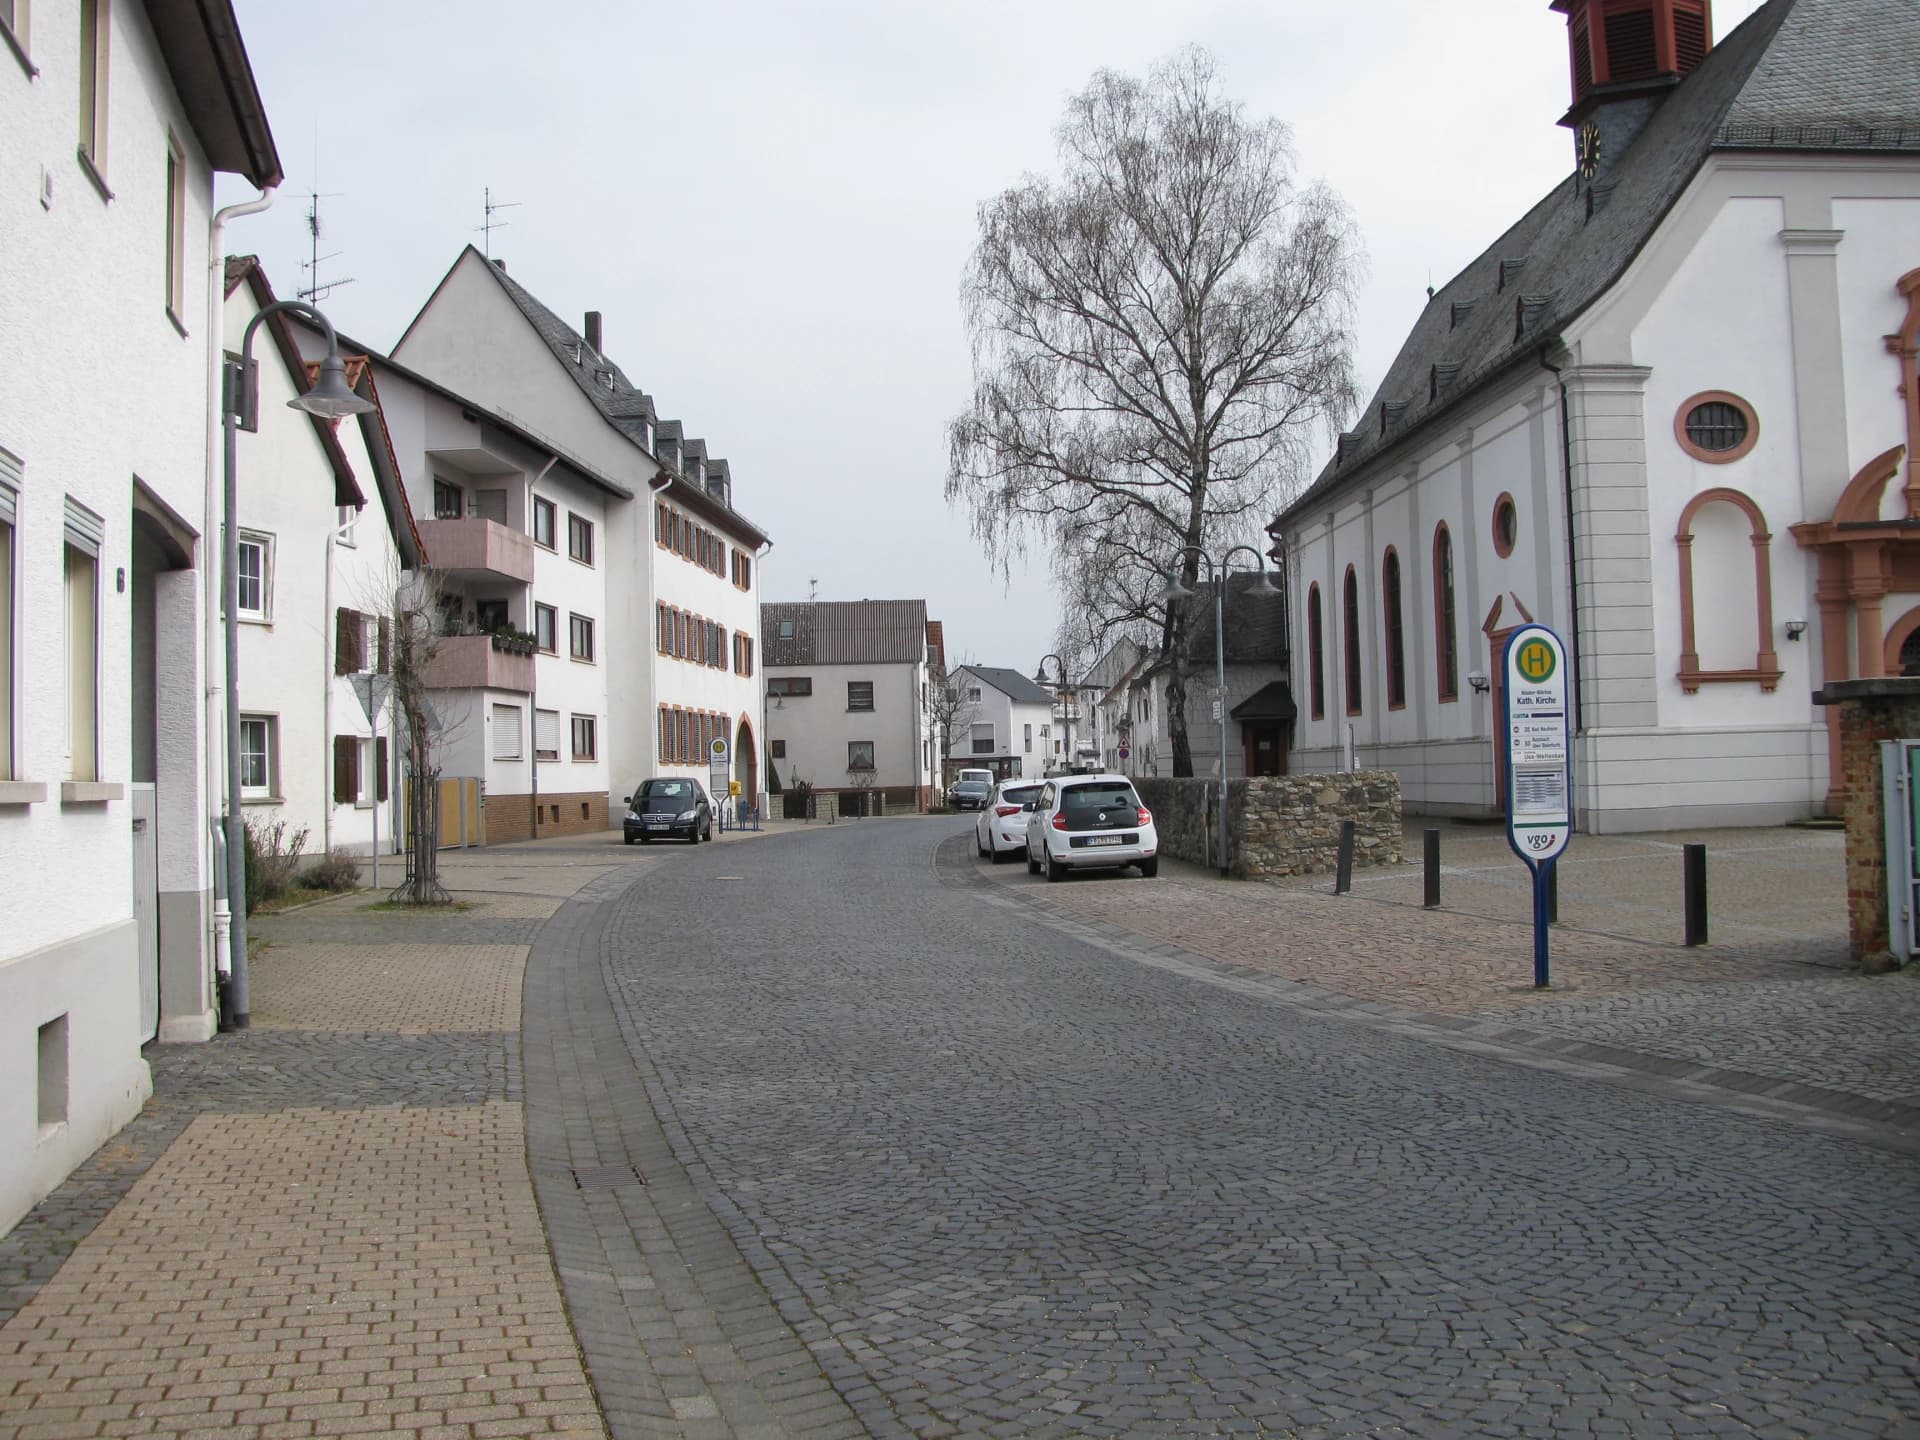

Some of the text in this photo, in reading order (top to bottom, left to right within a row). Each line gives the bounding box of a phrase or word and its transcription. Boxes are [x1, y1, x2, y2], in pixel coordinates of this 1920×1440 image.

[1528, 647, 1544, 673] H
[1516, 695, 1557, 705] Kath. Kirche
[1527, 834, 1548, 849] vgo
